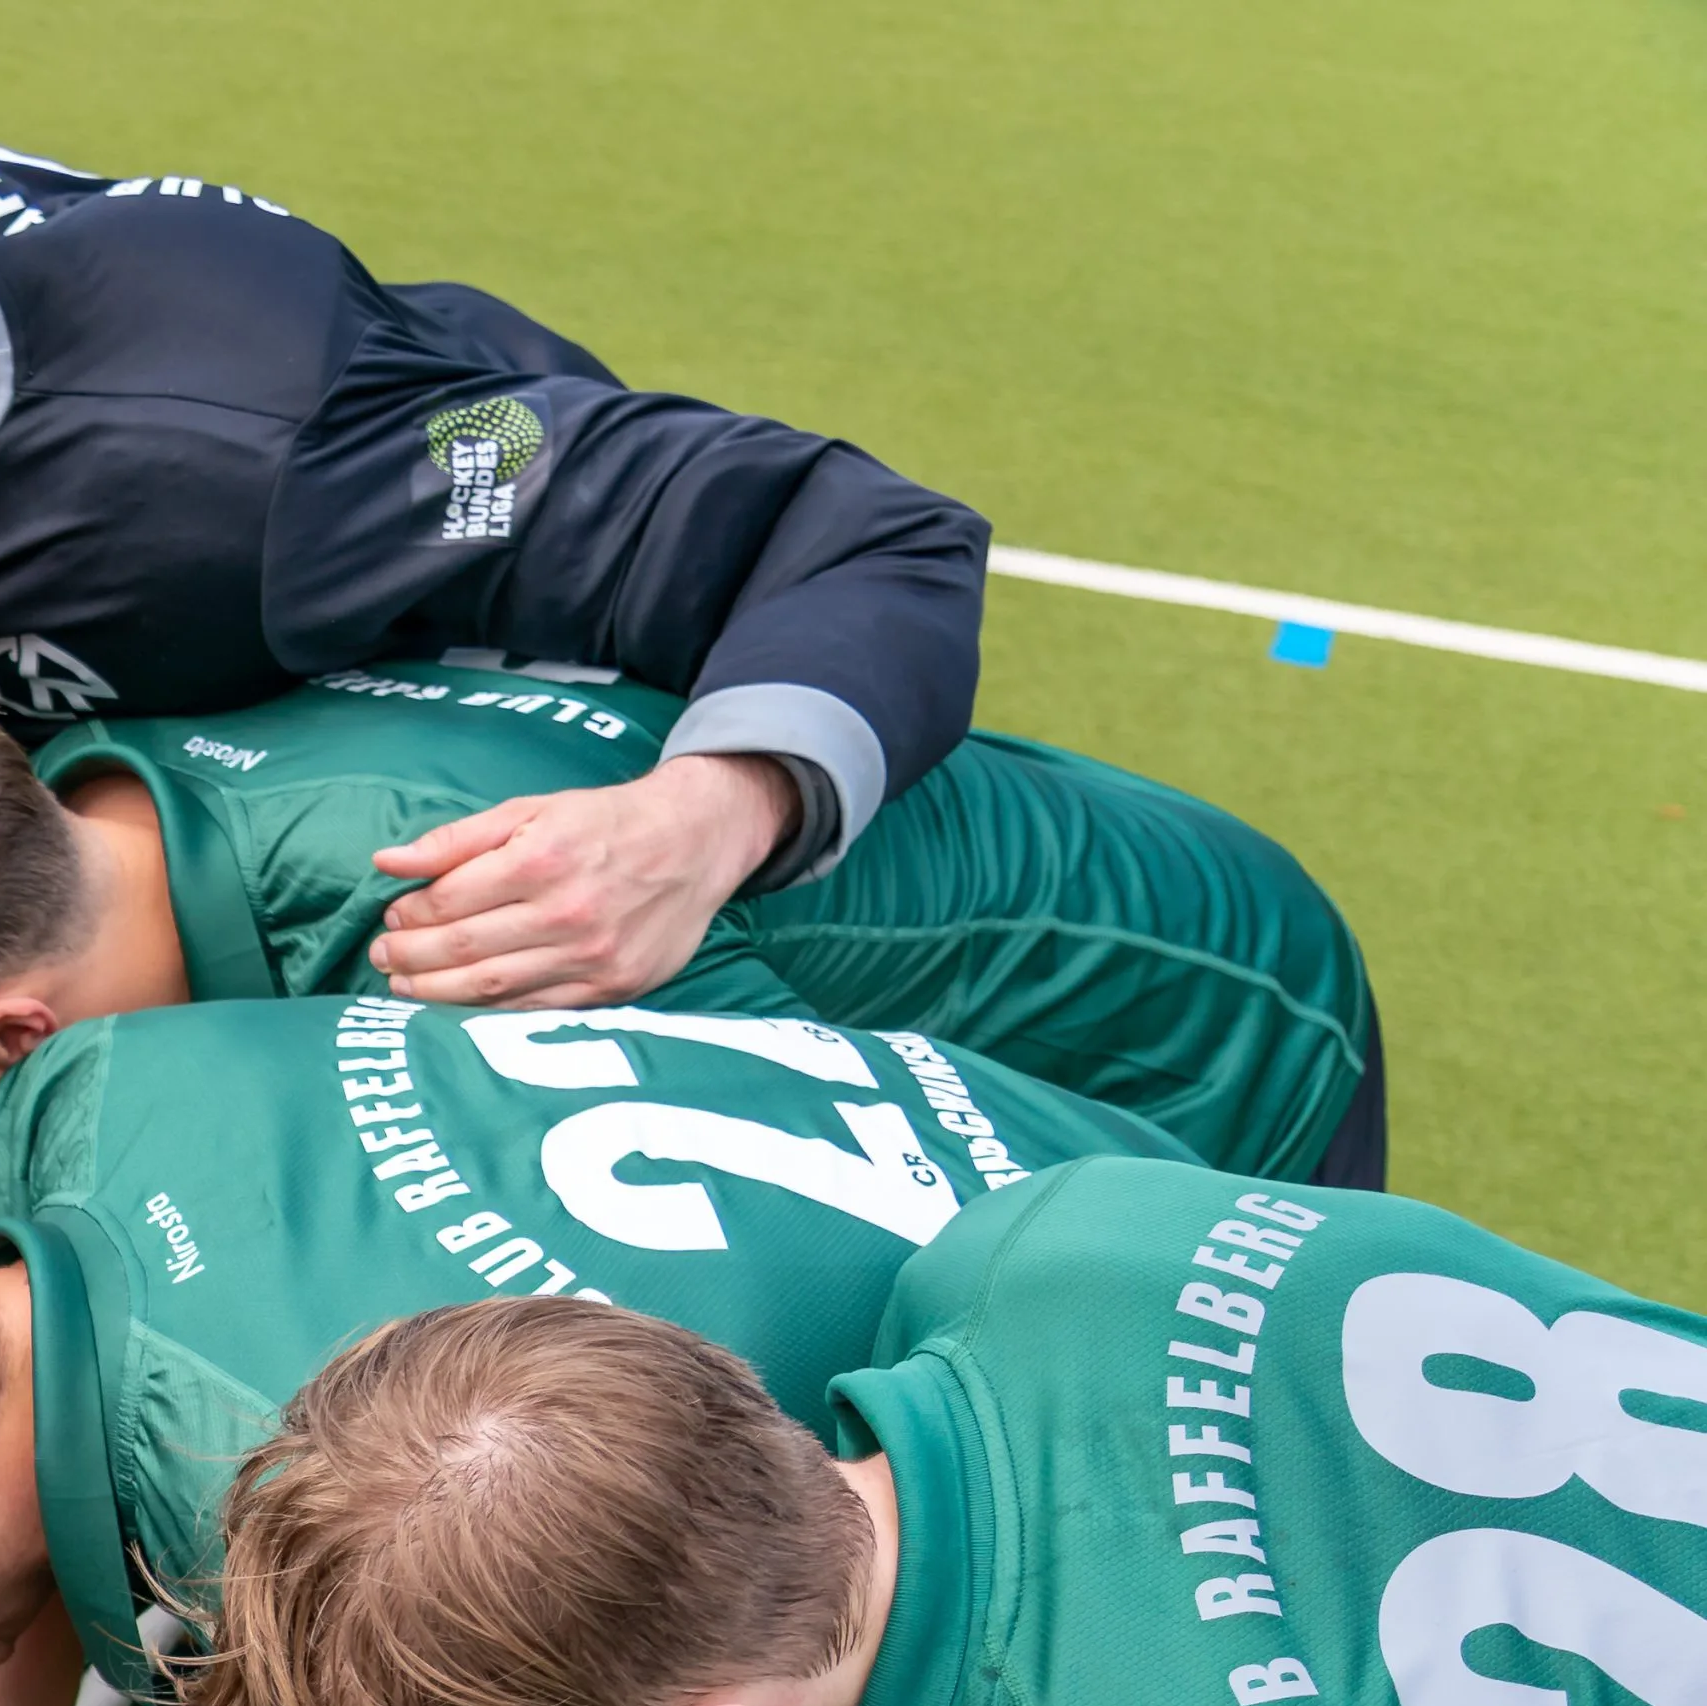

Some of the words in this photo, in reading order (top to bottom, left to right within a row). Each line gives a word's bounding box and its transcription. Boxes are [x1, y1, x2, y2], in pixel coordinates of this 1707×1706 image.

[442, 441, 475, 539] HOCKEY
[465, 440, 498, 537] BUNDES
[489, 484, 516, 537] LIGA
[460, 1005, 962, 1252] 22
[902, 1151, 936, 1188] CR
[145, 1191, 206, 1285] Nirosta
[1166, 1192, 1328, 1623] RAFFELBERG
